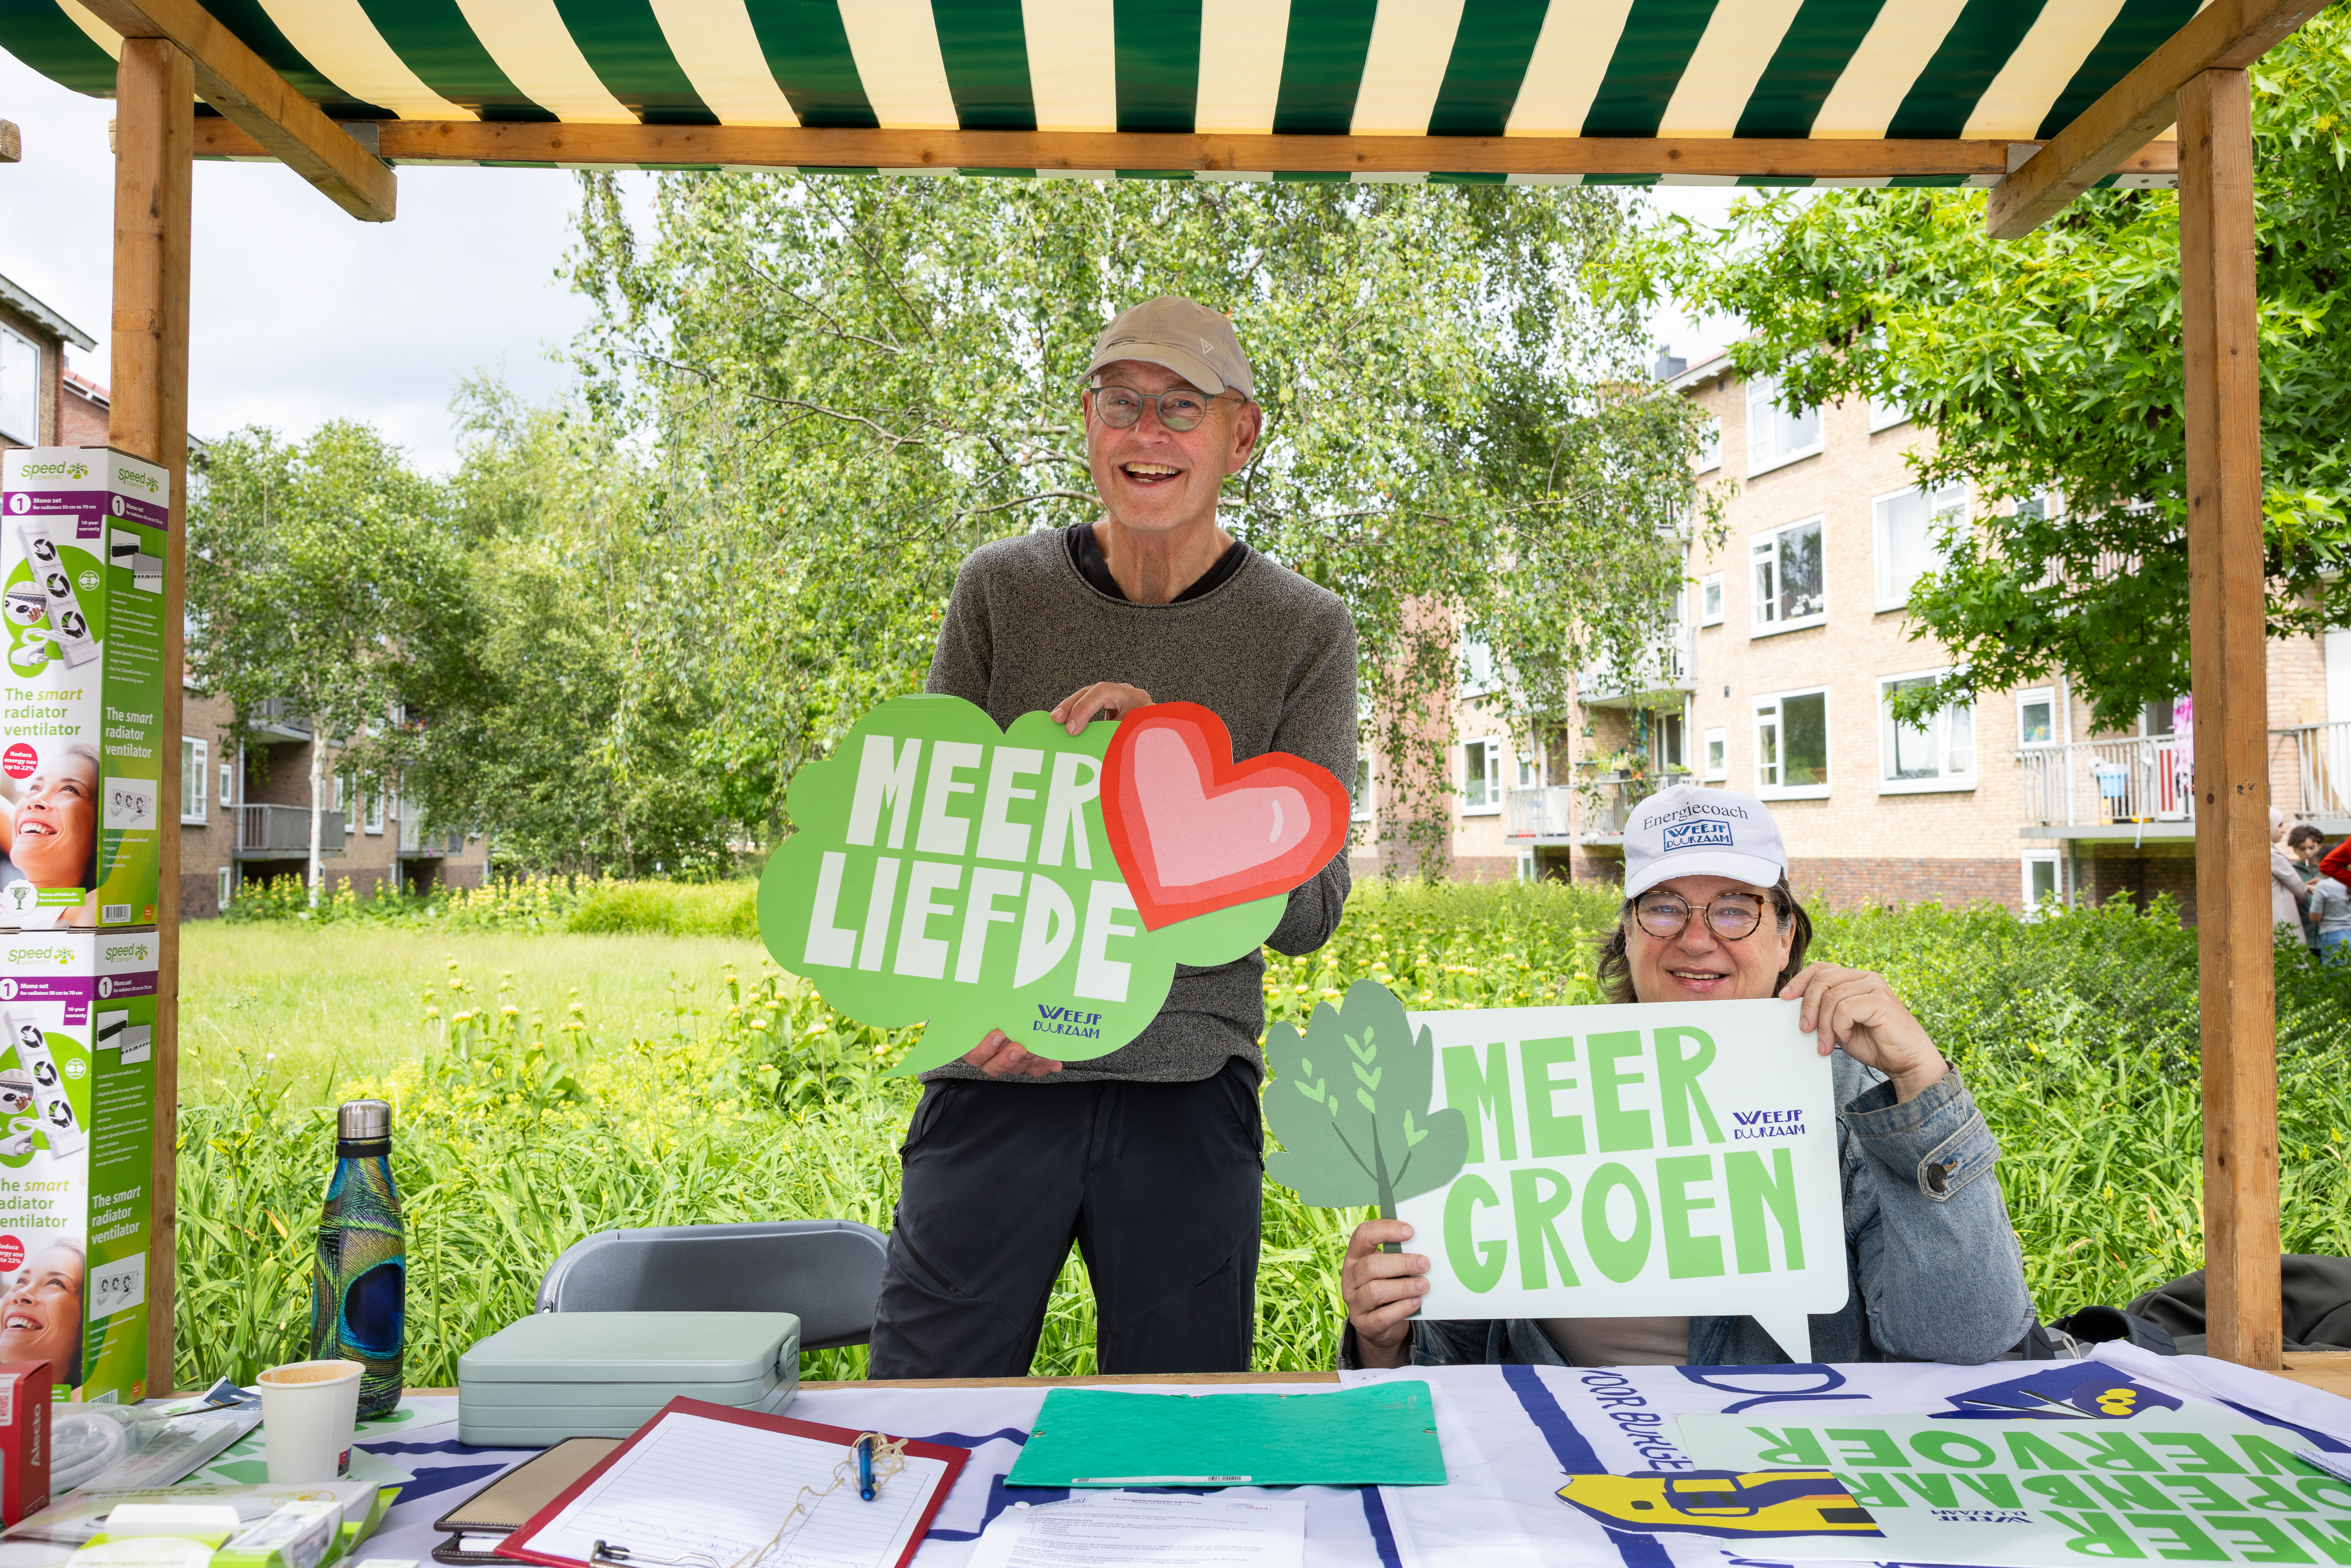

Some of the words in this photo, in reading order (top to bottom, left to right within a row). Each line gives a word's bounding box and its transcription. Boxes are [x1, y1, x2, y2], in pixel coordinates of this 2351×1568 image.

[21, 461, 66, 480] speed
[118, 468, 146, 484] speed
[126, 481, 144, 490] COMFORT
[17, 498, 23, 511] 1
[116, 500, 120, 513] 1
[126, 503, 137, 511] Mono
[5, 688, 33, 701] The
[38, 688, 83, 700] smart
[5, 705, 68, 718] radiator
[106, 707, 124, 721] The
[126, 711, 153, 725] smart
[4, 722, 81, 736] ventilator
[105, 725, 144, 740] radiator
[105, 743, 152, 758] ventilator
[846, 734, 1103, 870] MEER
[1643, 802, 1749, 831] Energiecoach
[1667, 824, 1726, 838] WEESP
[1667, 834, 1730, 849] DUURZAAM
[803, 851, 1139, 1003] LIEFDE
[8, 946, 53, 965] speed
[105, 943, 135, 963] speed
[4, 983, 10, 996] 1
[103, 981, 107, 995] 1
[1037, 1004, 1102, 1026] WEESP
[1033, 1021, 1100, 1039] DUURZAAM
[1441, 1026, 1726, 1164] MEER
[1732, 1109, 1803, 1126] WEESP
[1733, 1124, 1806, 1140] DUURZAAM
[24, 1180, 69, 1192] smart
[0, 1196, 55, 1210] adiator
[92, 1193, 111, 1209] The
[113, 1185, 141, 1203] smart
[0, 1214, 68, 1228] entilator
[92, 1206, 132, 1228] radiator
[1443, 1147, 1806, 1294] GROEN
[91, 1221, 140, 1245] ventilator
[30, 1403, 41, 1467] Alecto
[1609, 1412, 1693, 1470] BURGE
[1745, 1427, 2329, 1477] VERVOER
